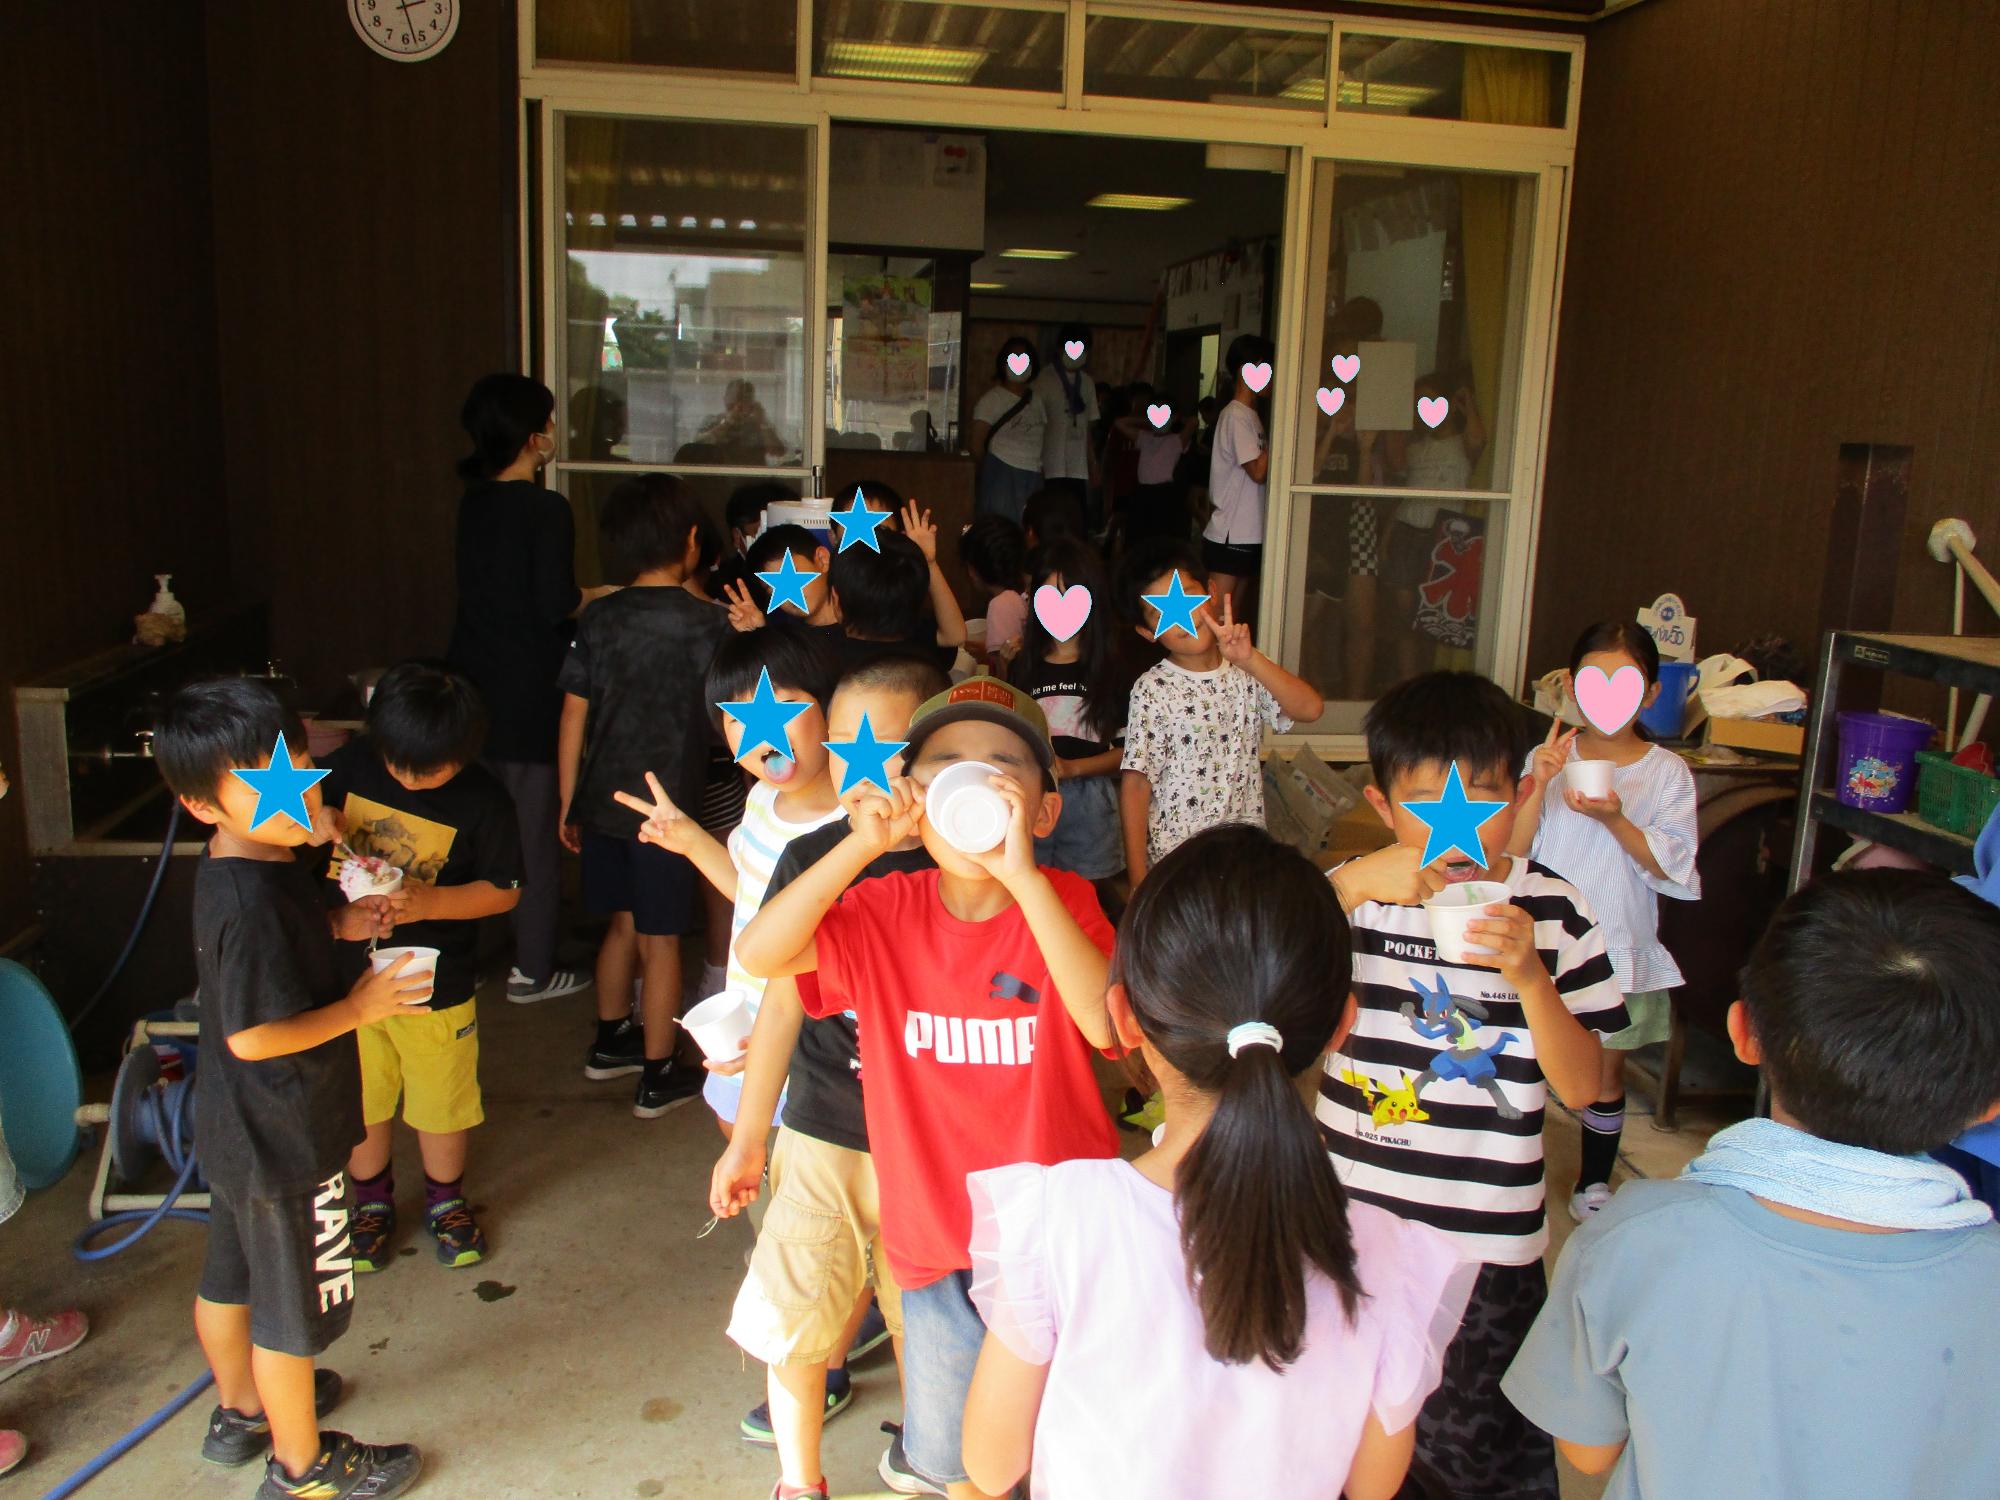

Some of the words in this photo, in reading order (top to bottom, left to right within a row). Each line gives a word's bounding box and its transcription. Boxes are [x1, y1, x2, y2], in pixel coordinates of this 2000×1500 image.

[435, 3, 442, 14] 3
[373, 16, 381, 27] 8
[429, 19, 437, 30] 4
[386, 29, 393, 40] 7
[402, 34, 410, 45] 6
[418, 31, 426, 41] 5
[1042, 684, 1057, 693] me
[1059, 682, 1077, 690] feel
[1380, 1136, 1412, 1147] PIKACHU
